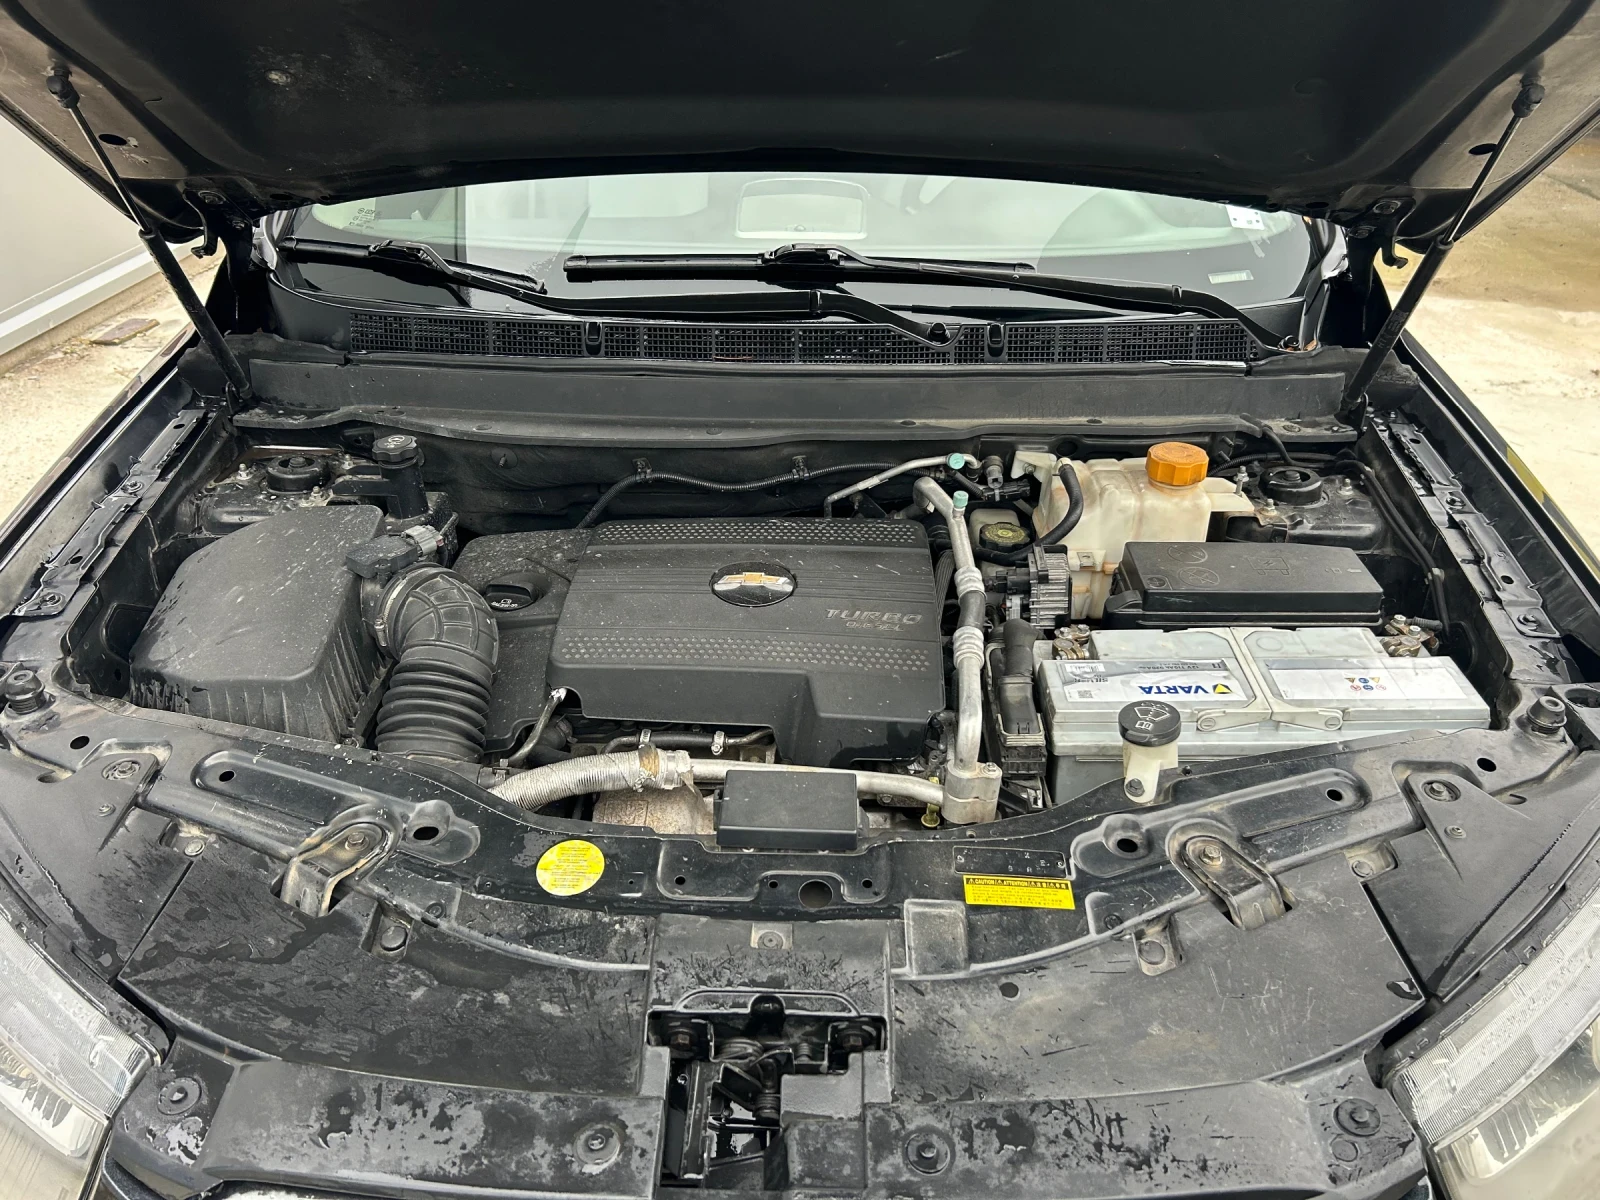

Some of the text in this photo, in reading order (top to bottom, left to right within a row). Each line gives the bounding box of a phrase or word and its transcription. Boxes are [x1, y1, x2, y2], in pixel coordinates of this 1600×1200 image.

[825, 609, 922, 624] TURBO
[846, 621, 904, 631] DIESEL
[1138, 685, 1210, 694] VARTA
